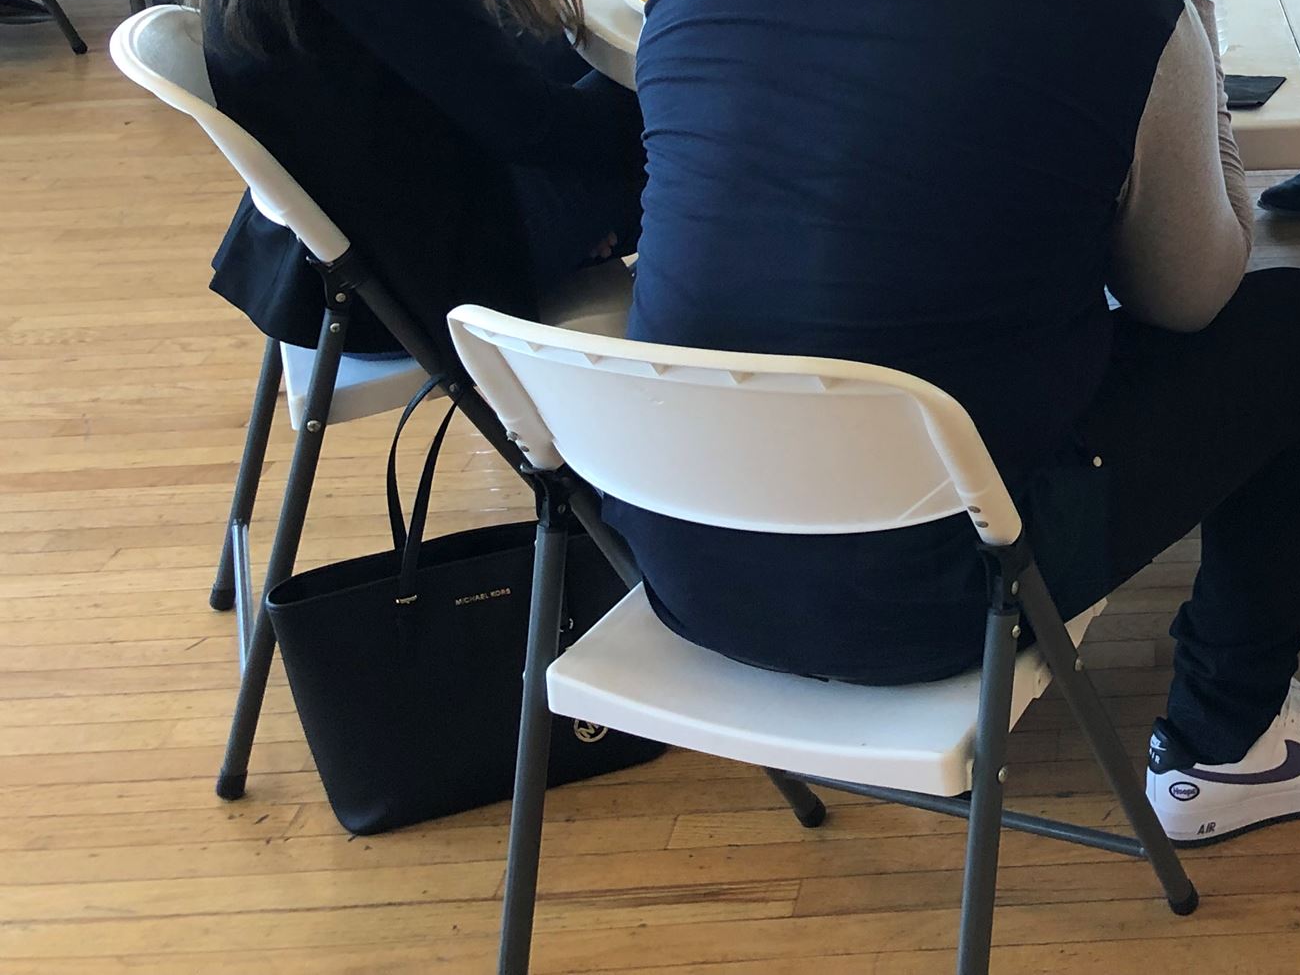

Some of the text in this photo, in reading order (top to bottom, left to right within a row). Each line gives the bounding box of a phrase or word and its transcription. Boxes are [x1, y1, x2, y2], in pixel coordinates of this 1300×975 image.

[455, 587, 511, 605] MICHAEL KORS
[1197, 822, 1216, 835] AIR
